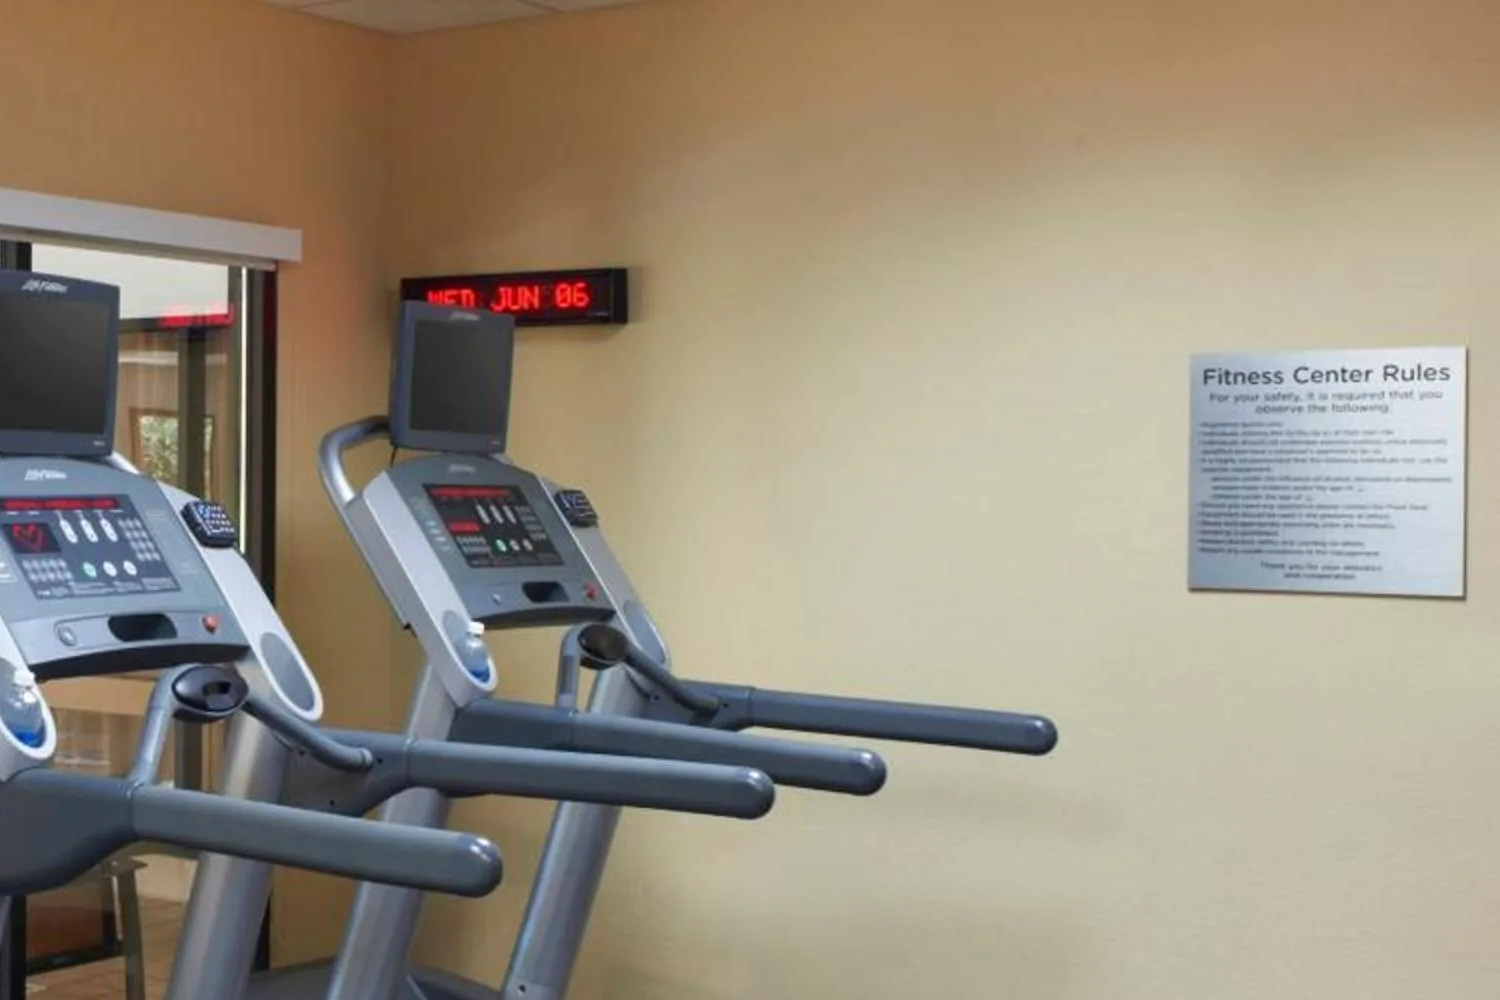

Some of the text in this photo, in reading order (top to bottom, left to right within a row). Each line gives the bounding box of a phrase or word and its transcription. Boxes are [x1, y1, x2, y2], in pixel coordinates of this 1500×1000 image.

[491, 285, 540, 311] JUN
[555, 282, 590, 308] 06
[1202, 362, 1451, 386] Fitness Center Rules
[1209, 392, 1231, 403] For
[1234, 393, 1260, 404] your
[1419, 391, 1444, 402] you
